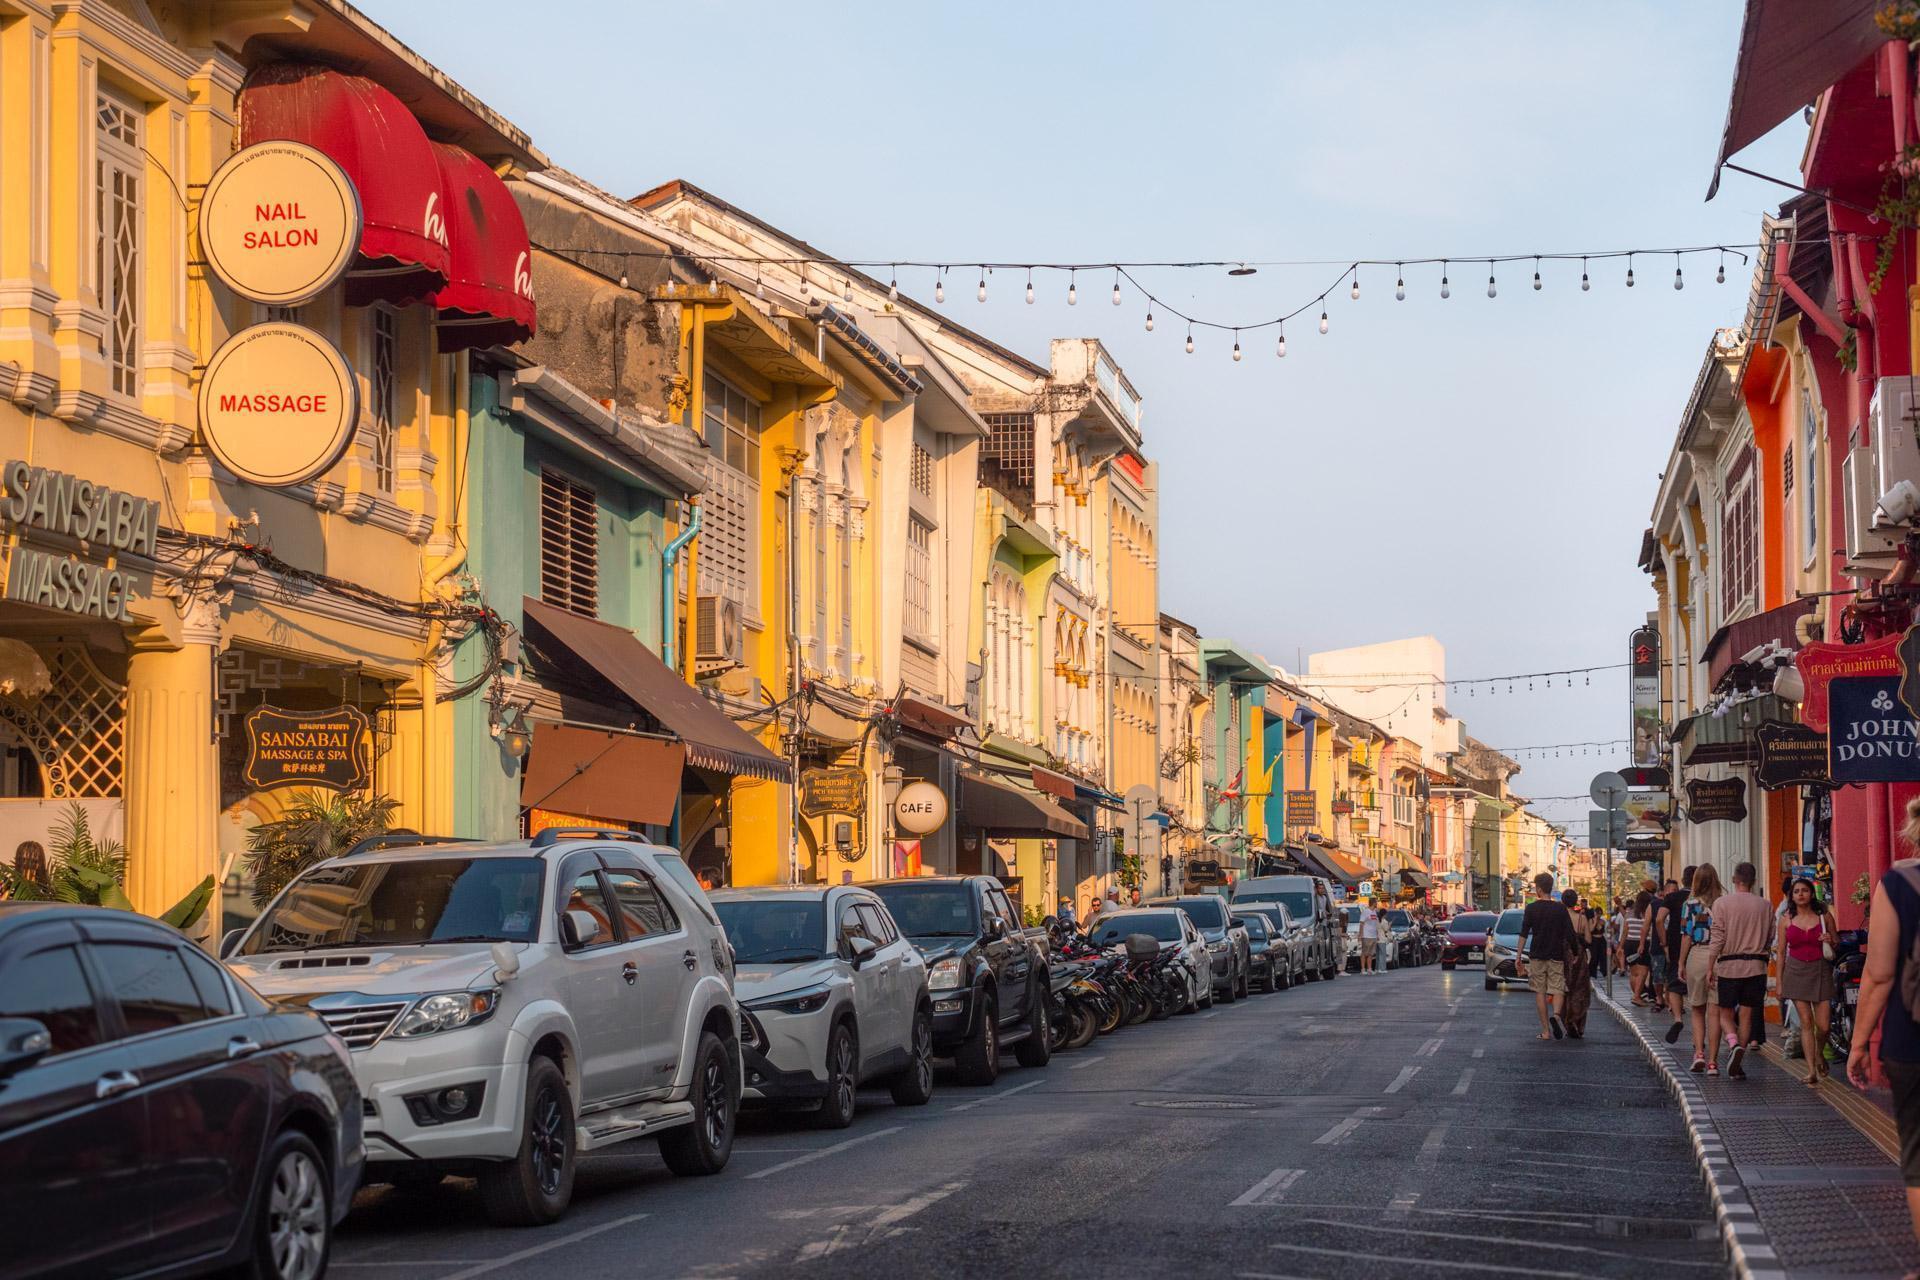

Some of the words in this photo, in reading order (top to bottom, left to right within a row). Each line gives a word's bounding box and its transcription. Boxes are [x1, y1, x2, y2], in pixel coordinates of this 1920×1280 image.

[255, 202, 306, 222] NAIL
[244, 229, 318, 249] SALON
[220, 394, 327, 413] MASSAGE
[6, 461, 161, 557] SANSABAI
[15, 549, 138, 623] MASSAGE
[261, 732, 347, 747] SANSABAI
[1846, 720, 1920, 741] JOHN
[261, 750, 314, 761] MASSAGE
[316, 750, 326, 761] &
[327, 750, 348, 761] SPA
